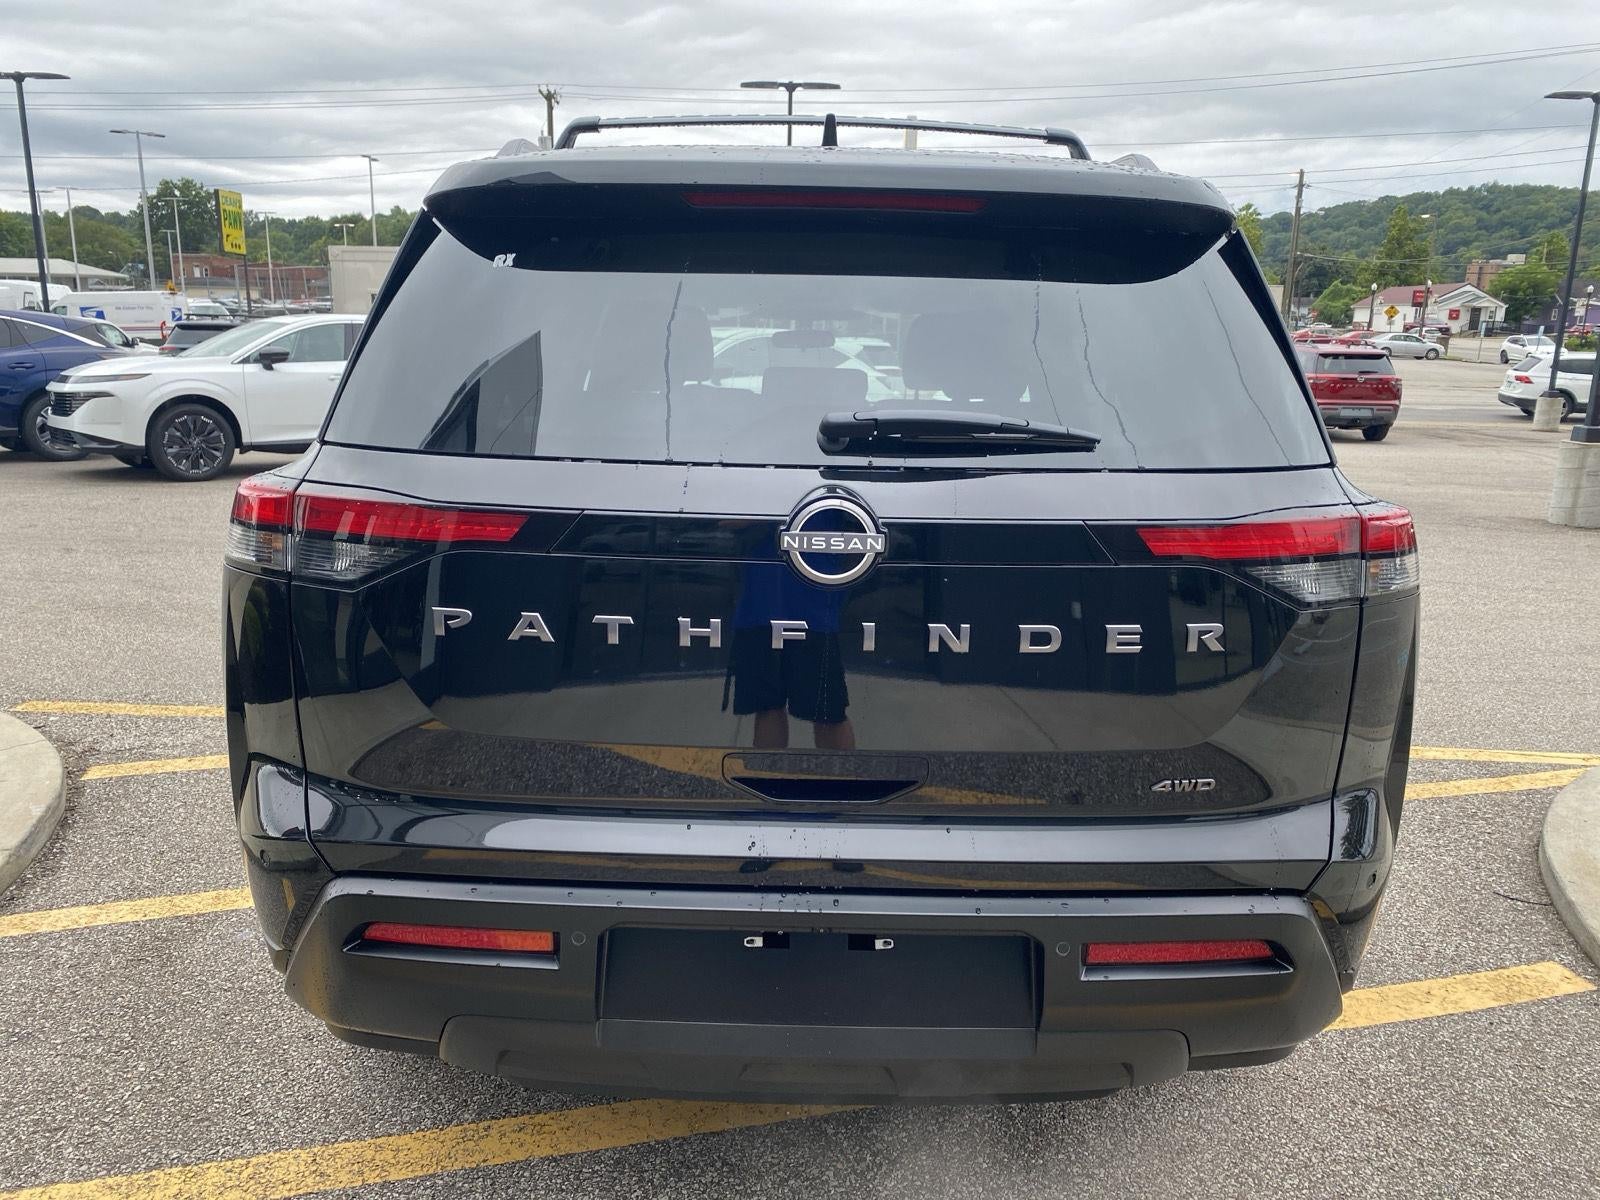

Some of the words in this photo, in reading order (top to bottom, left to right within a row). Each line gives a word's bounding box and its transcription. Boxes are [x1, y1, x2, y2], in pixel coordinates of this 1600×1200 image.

[223, 209, 243, 231] PAWN
[783, 535, 882, 550] NISSAN
[431, 606, 1226, 654] PATHFINDER
[1150, 778, 1216, 793] 4WD
